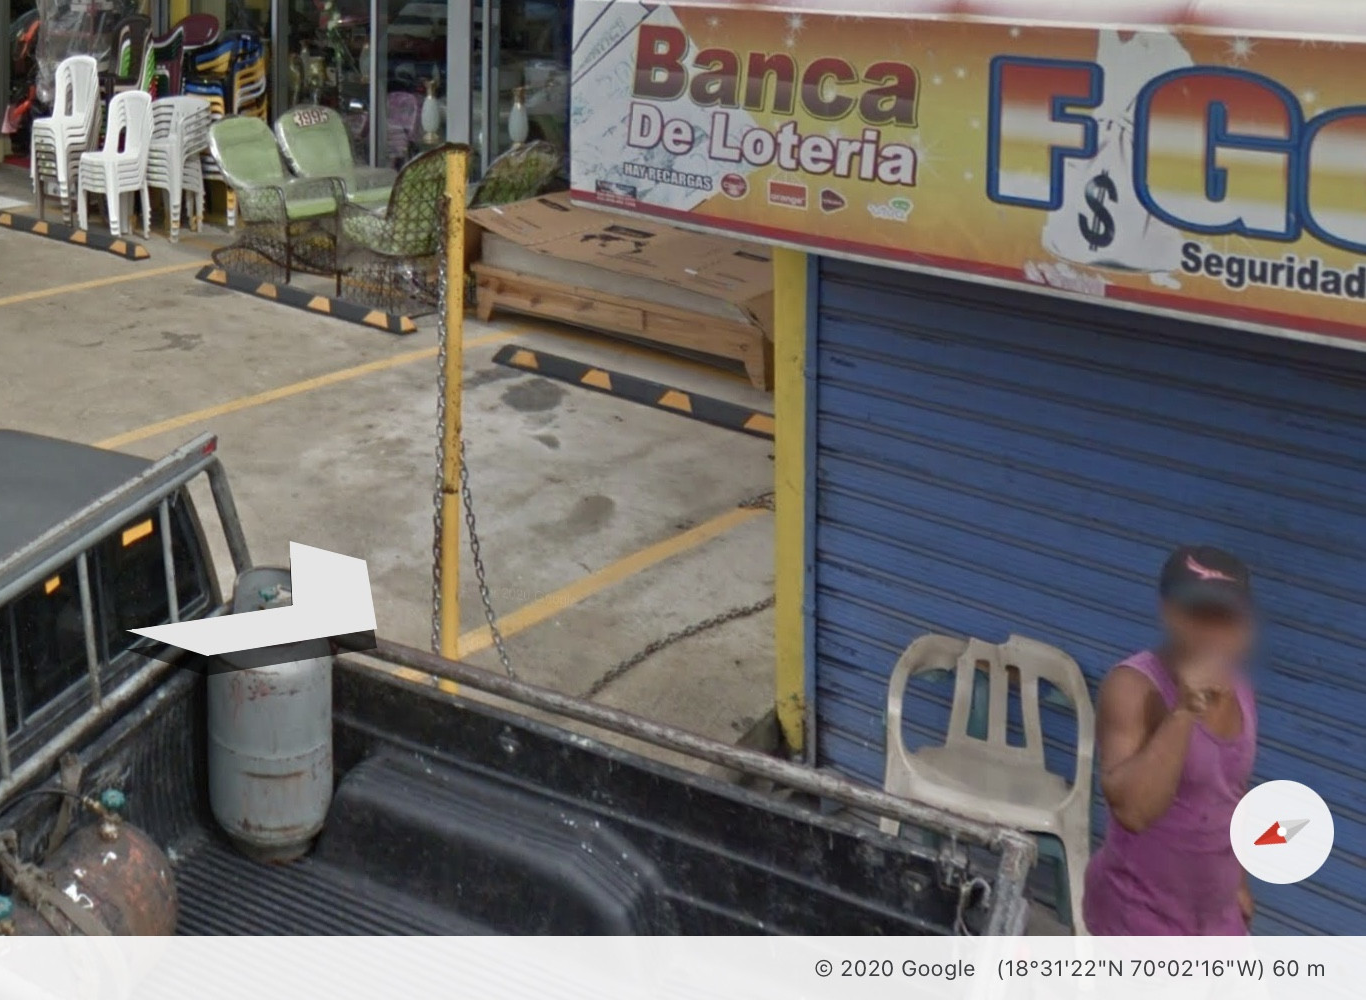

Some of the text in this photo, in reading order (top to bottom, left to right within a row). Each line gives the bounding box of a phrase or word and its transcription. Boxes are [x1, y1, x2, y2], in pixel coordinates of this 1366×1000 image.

[632, 23, 919, 128] Banca
[623, 163, 649, 182] HAY
[650, 166, 713, 191] RECARGAS
[627, 101, 918, 187] De Loteria
[1180, 242, 1366, 298] Seguridad
